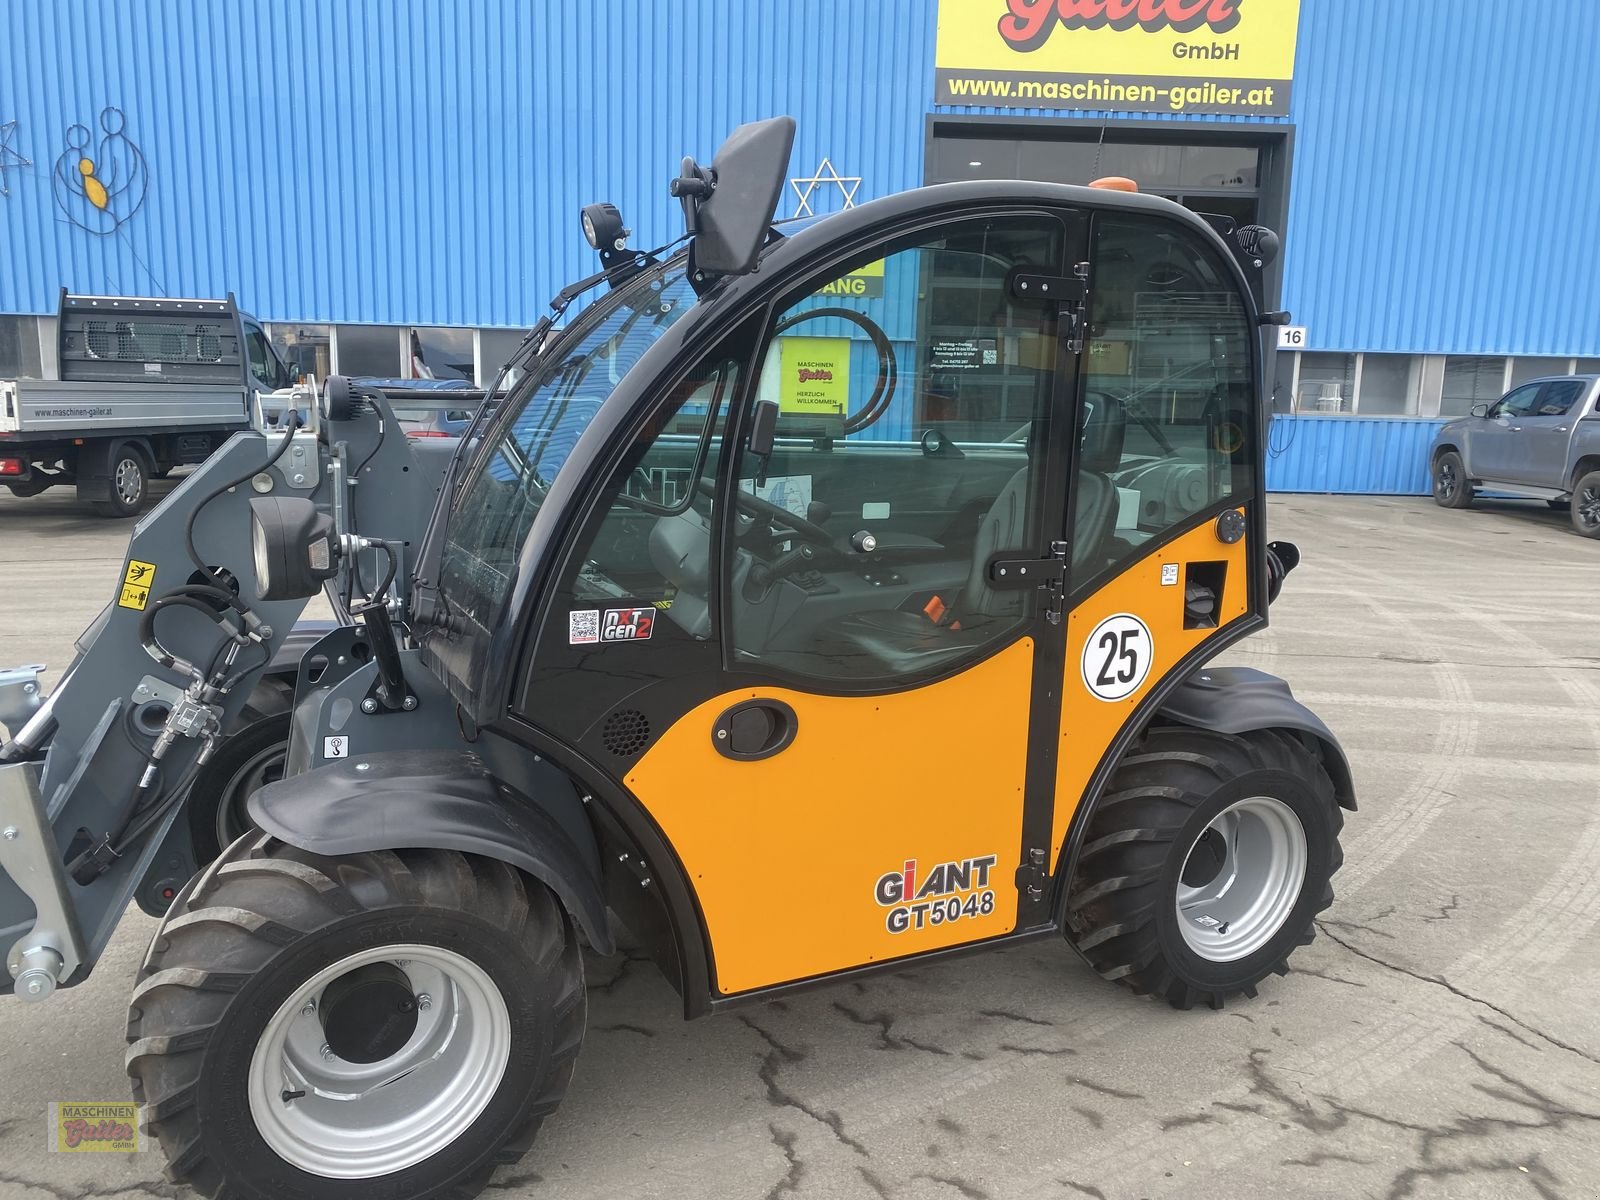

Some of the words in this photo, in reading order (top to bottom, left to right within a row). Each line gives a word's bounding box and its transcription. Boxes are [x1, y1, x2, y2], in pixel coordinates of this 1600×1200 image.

[1172, 42, 1239, 60] GmbH
[949, 78, 1273, 110] www.maschinen-gailer.at
[1284, 330, 1301, 344] 16
[34, 407, 113, 418] www.maschinen-gailer.at
[1096, 629, 1139, 687] 25
[886, 890, 995, 934] GT5048
